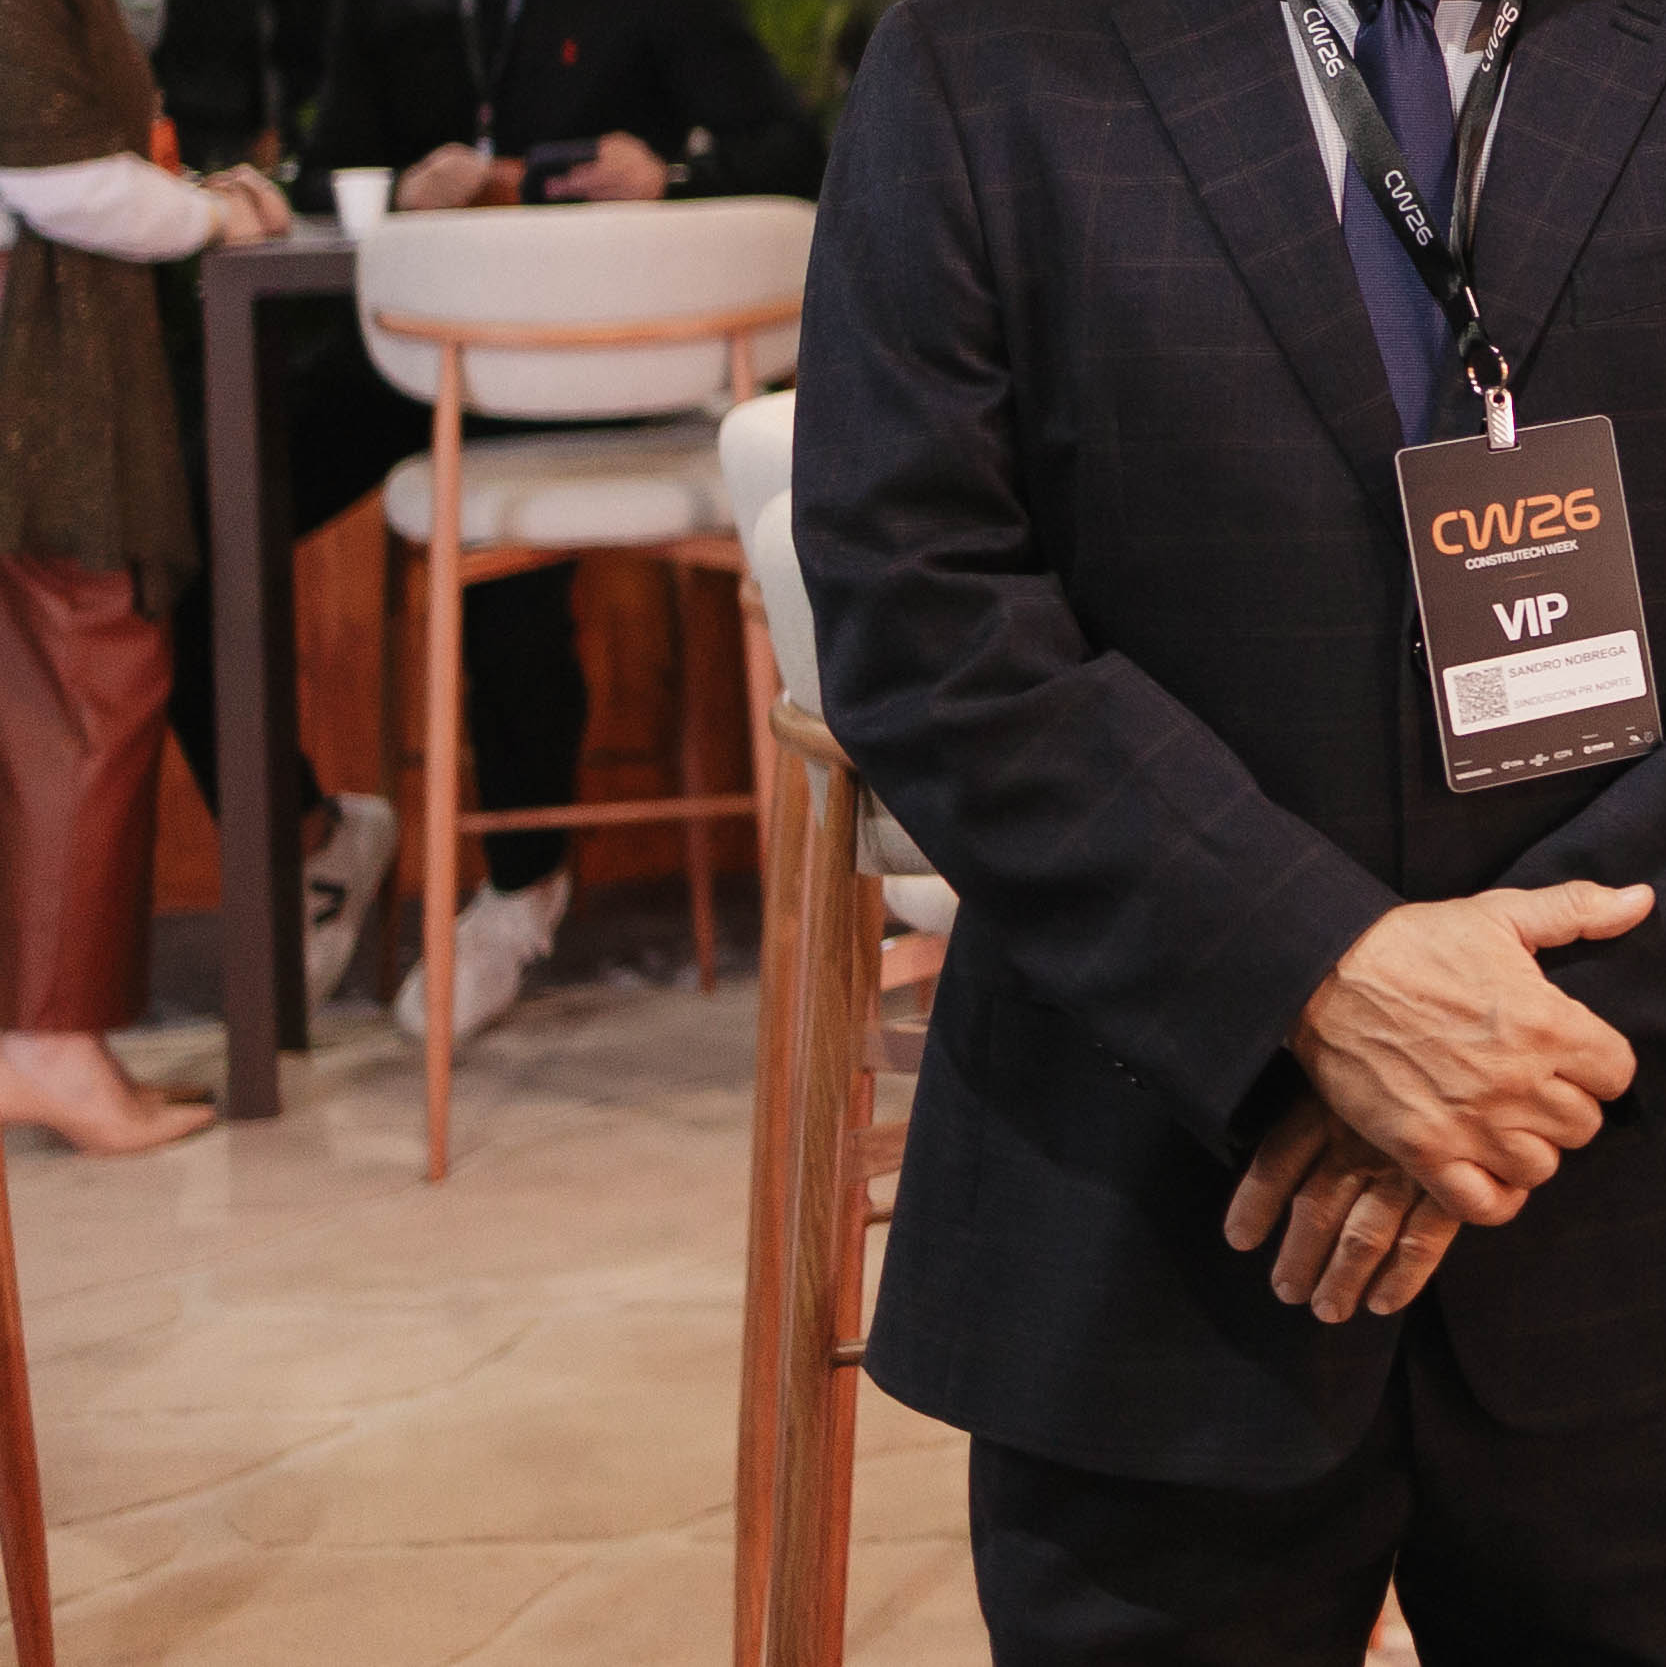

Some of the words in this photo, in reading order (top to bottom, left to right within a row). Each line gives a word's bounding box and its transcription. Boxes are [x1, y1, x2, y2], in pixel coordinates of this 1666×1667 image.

[1303, 7, 1345, 78] CW26
[1384, 169, 1433, 246] CW26
[1432, 487, 1601, 555] CW26
[1465, 545, 1546, 570] CONSTRUTECH
[1545, 539, 1580, 555] WEEK
[1492, 592, 1569, 642] VIP
[1508, 659, 1561, 678] SANDRO
[1565, 646, 1627, 667] NOBREGA
